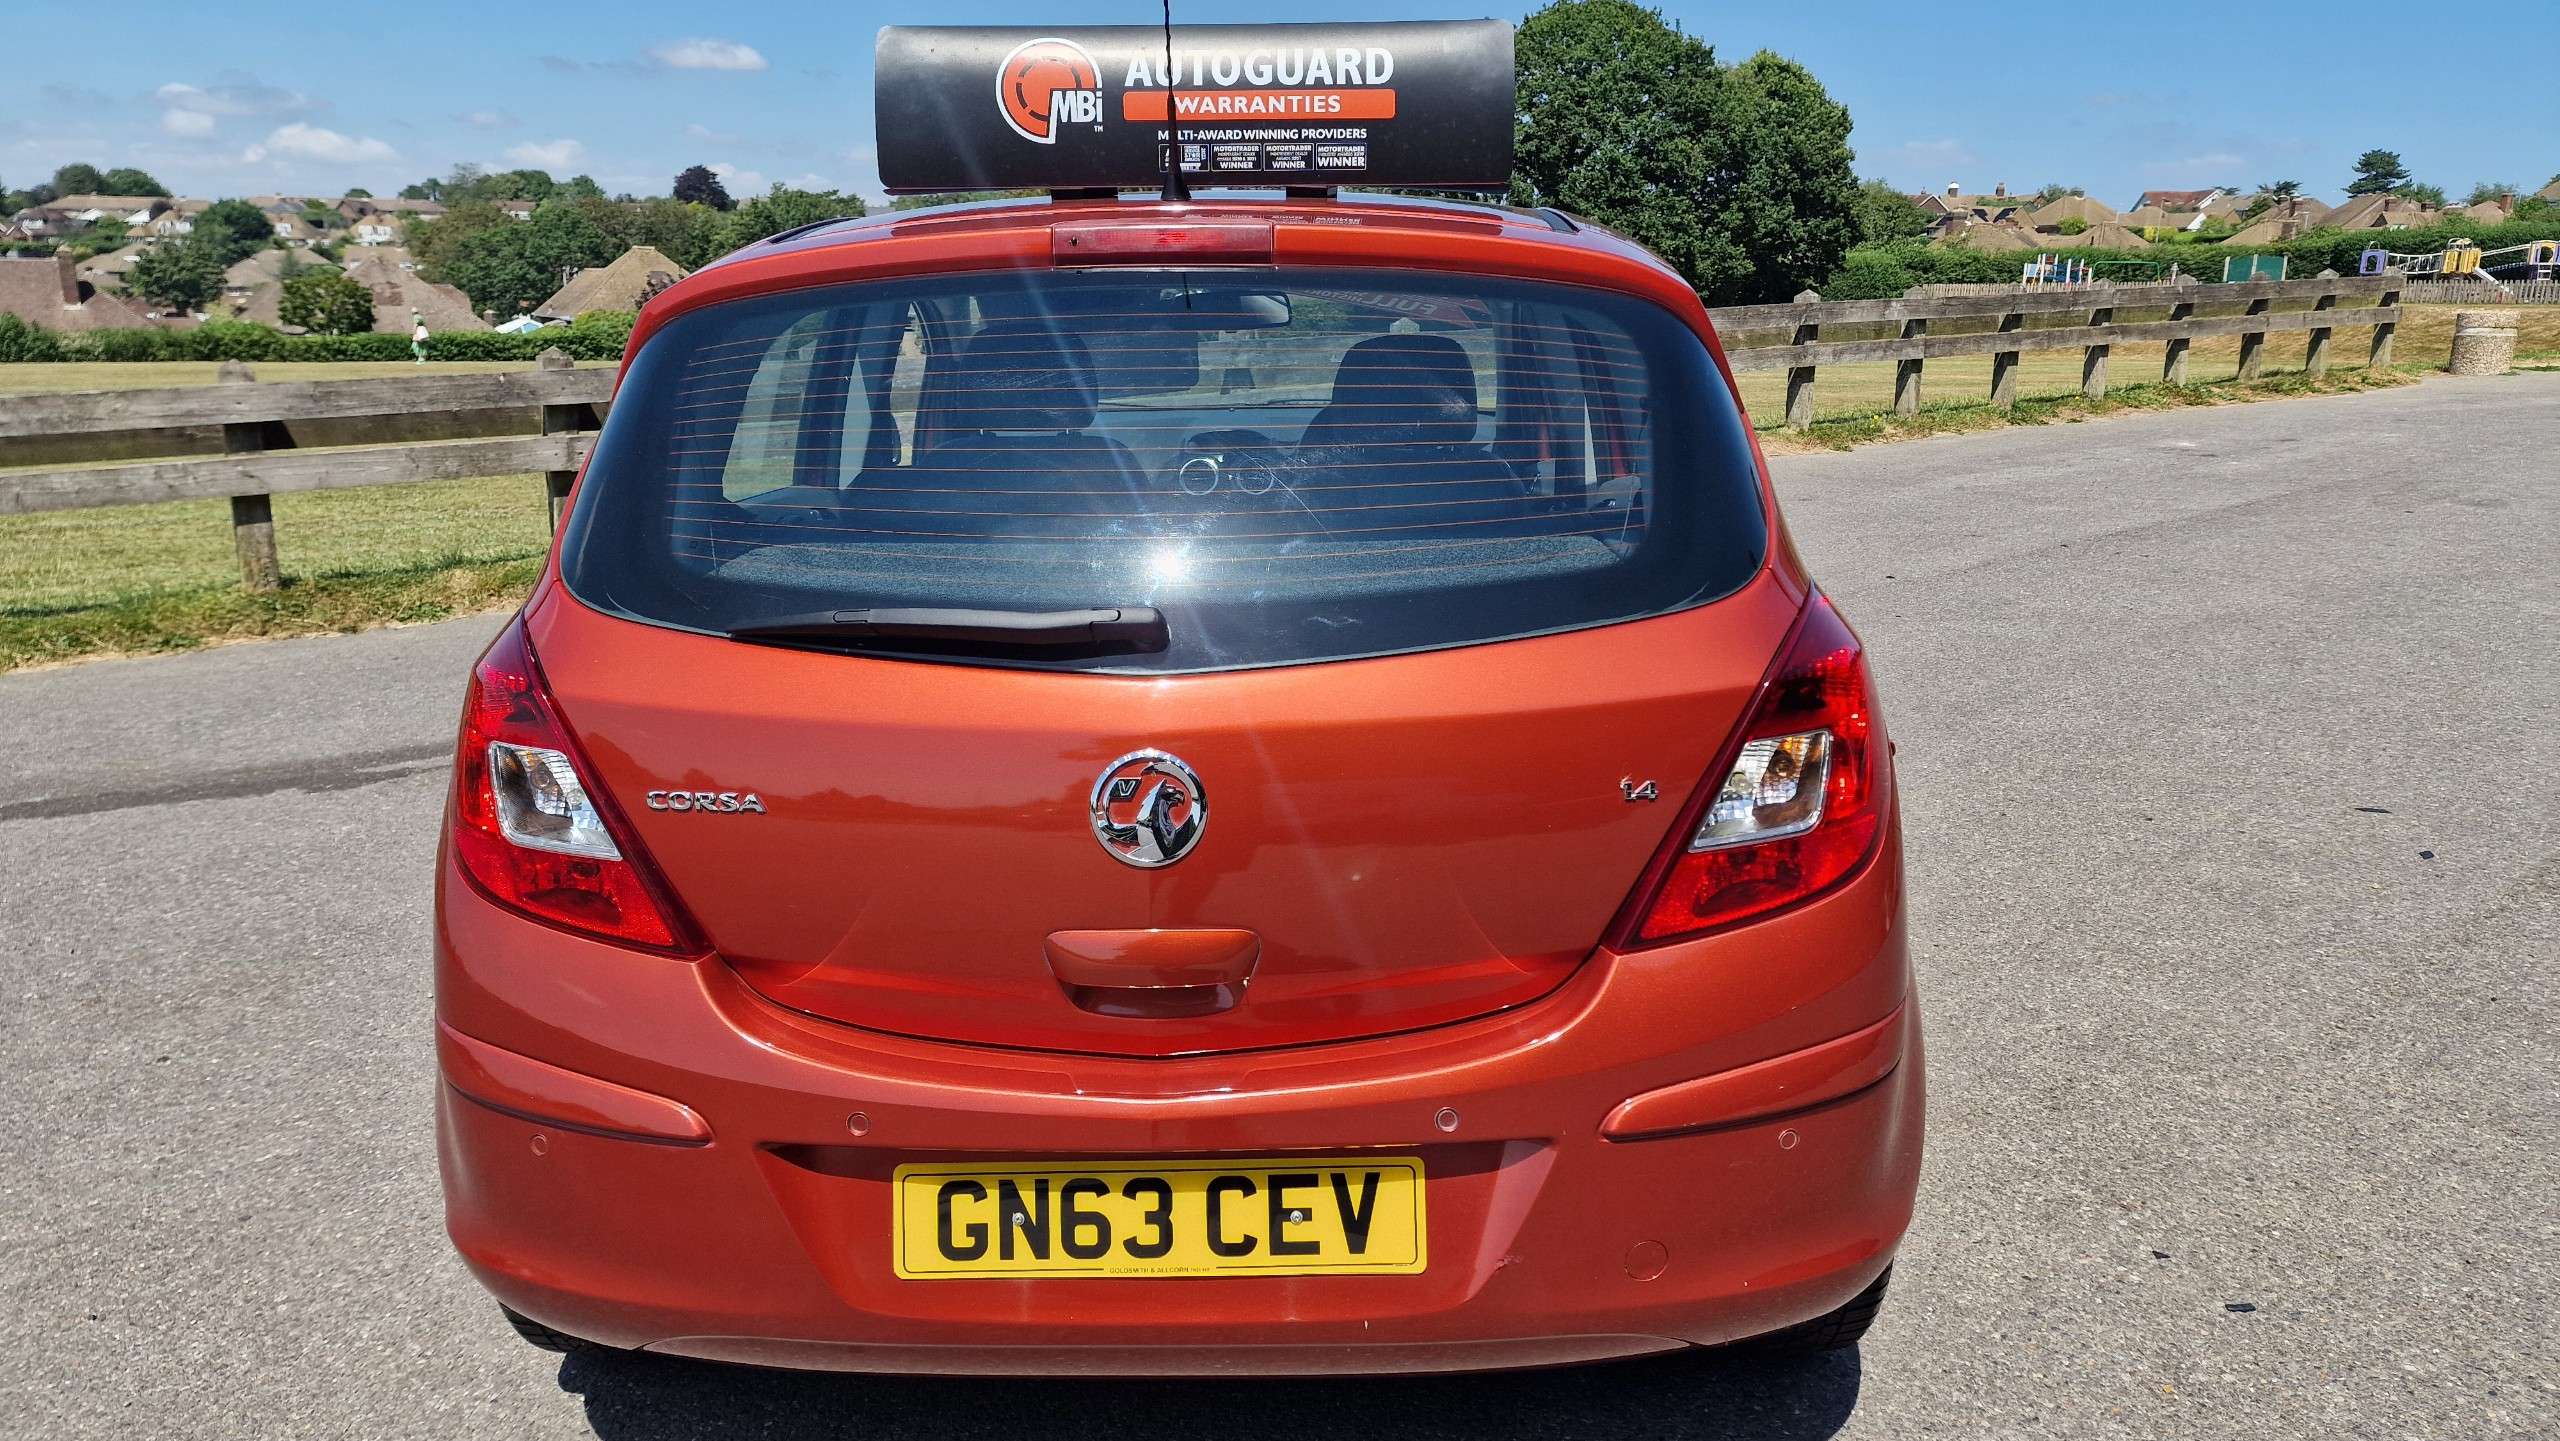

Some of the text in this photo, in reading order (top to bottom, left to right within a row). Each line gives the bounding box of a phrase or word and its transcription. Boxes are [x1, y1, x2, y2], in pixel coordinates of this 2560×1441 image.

[1125, 47, 1394, 87] AUTOGUARD
[1052, 91, 1103, 123] MBi
[1174, 95, 1341, 114] WARRANTIES
[1158, 128, 1367, 140] MLTI-AWARD WINNING PROVIDERS
[1220, 161, 1253, 169] WINNER
[1272, 160, 1306, 168] WINNER
[1317, 157, 1365, 167] WINNER
[646, 790, 768, 814] CORSA
[936, 1171, 1382, 1262] GN63 CEV
